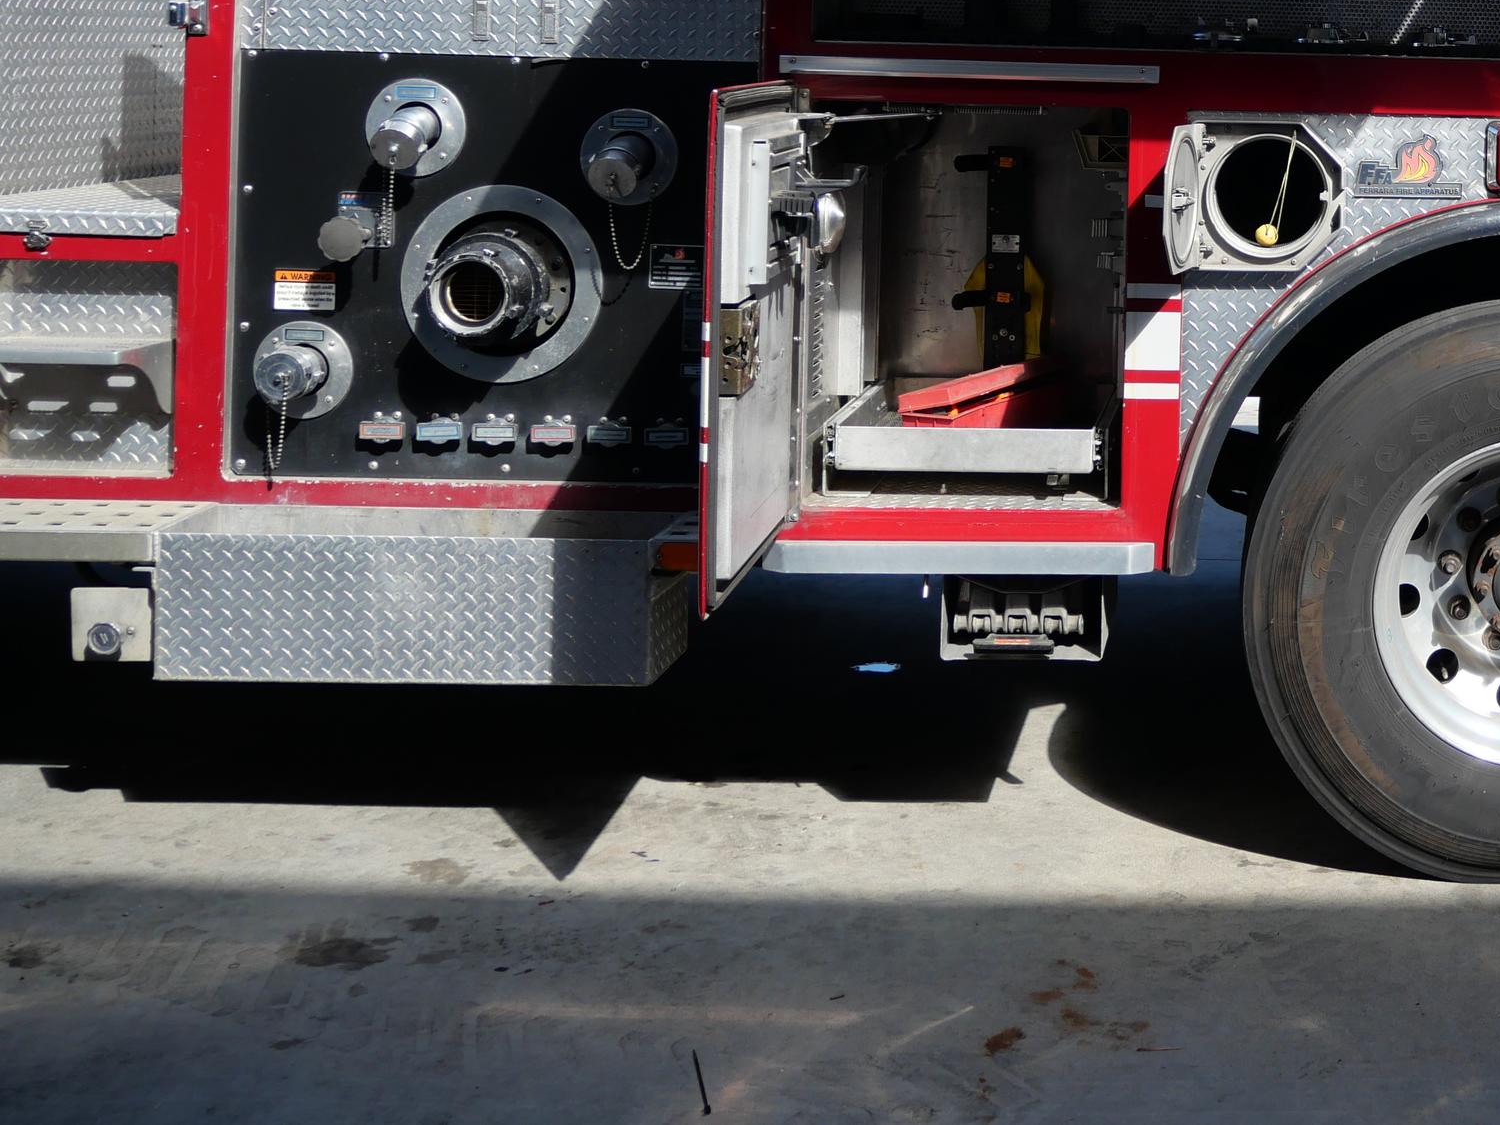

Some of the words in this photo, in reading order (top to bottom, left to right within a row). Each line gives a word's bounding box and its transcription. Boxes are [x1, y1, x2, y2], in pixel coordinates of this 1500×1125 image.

[1359, 163, 1392, 185] FFA
[1359, 187, 1394, 195] FERRARA
[1396, 187, 1414, 195] FIRE
[1415, 187, 1460, 195] APPARATUS
[290, 272, 332, 281] WARNING
